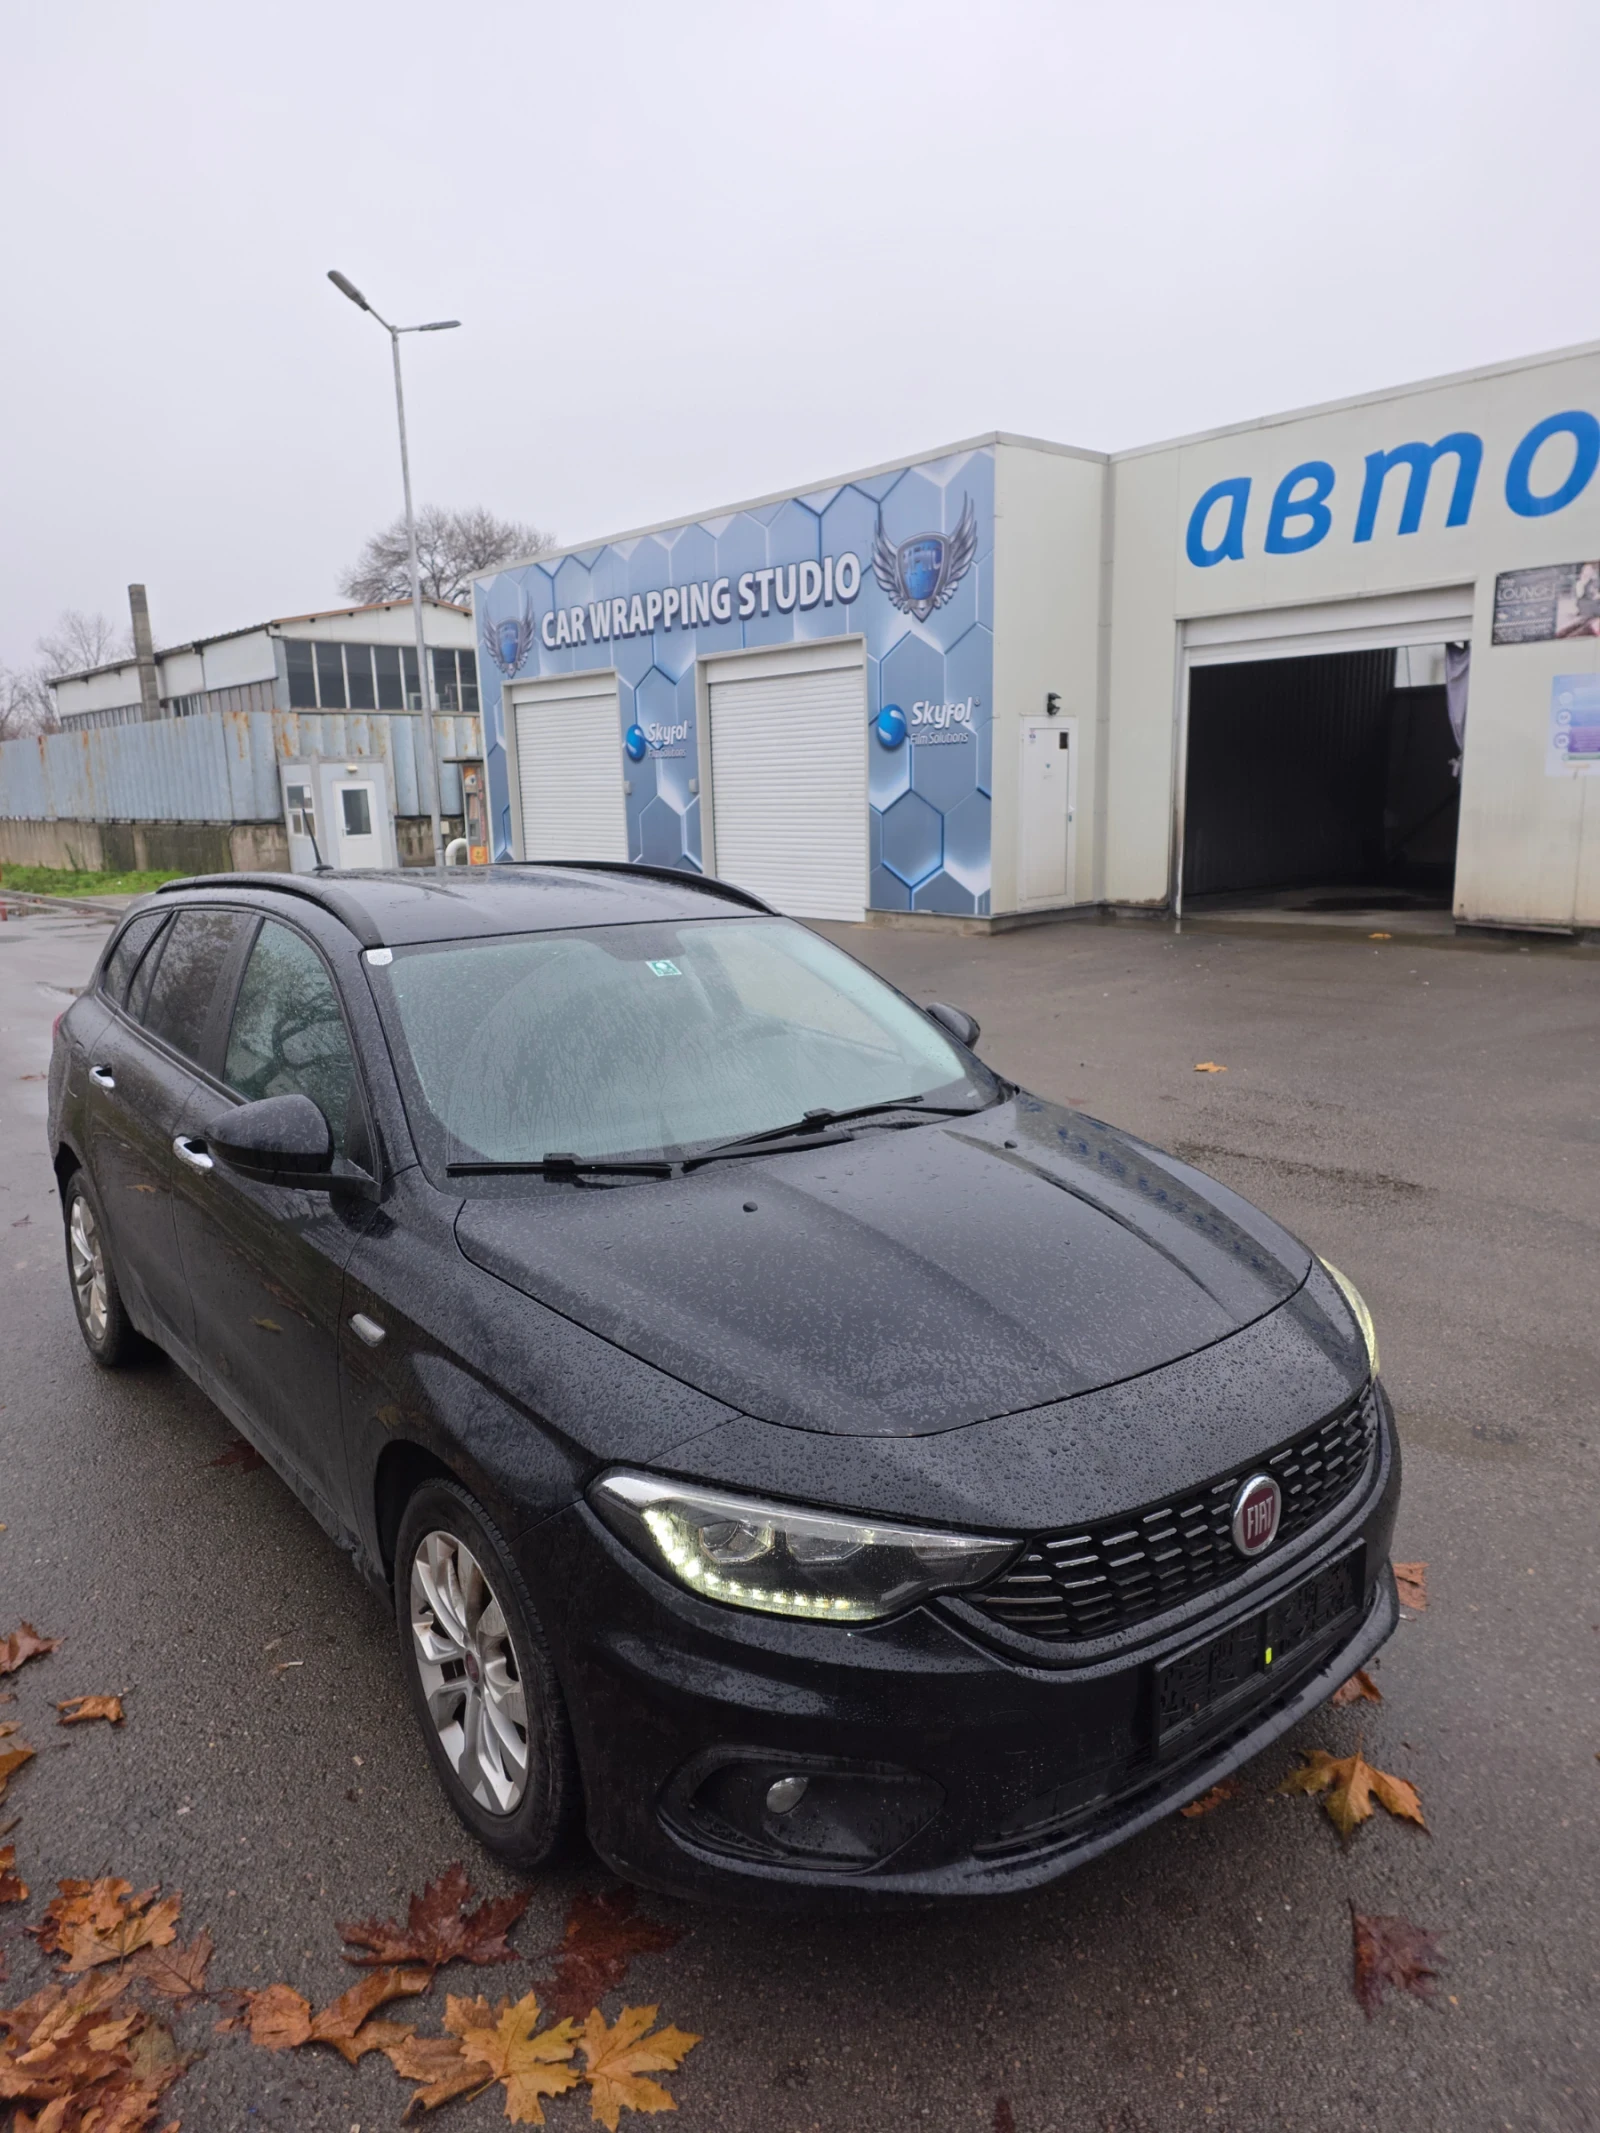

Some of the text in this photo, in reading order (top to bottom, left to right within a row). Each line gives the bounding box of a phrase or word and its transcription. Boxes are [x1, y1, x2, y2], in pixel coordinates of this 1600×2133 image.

[1186, 410, 1600, 568] авто
[541, 605, 587, 650] CAR
[588, 577, 732, 642] WRAPPING
[737, 551, 861, 619] STUDIO
[910, 732, 969, 745] Film Solutions
[1247, 1496, 1274, 1540] FIAT
